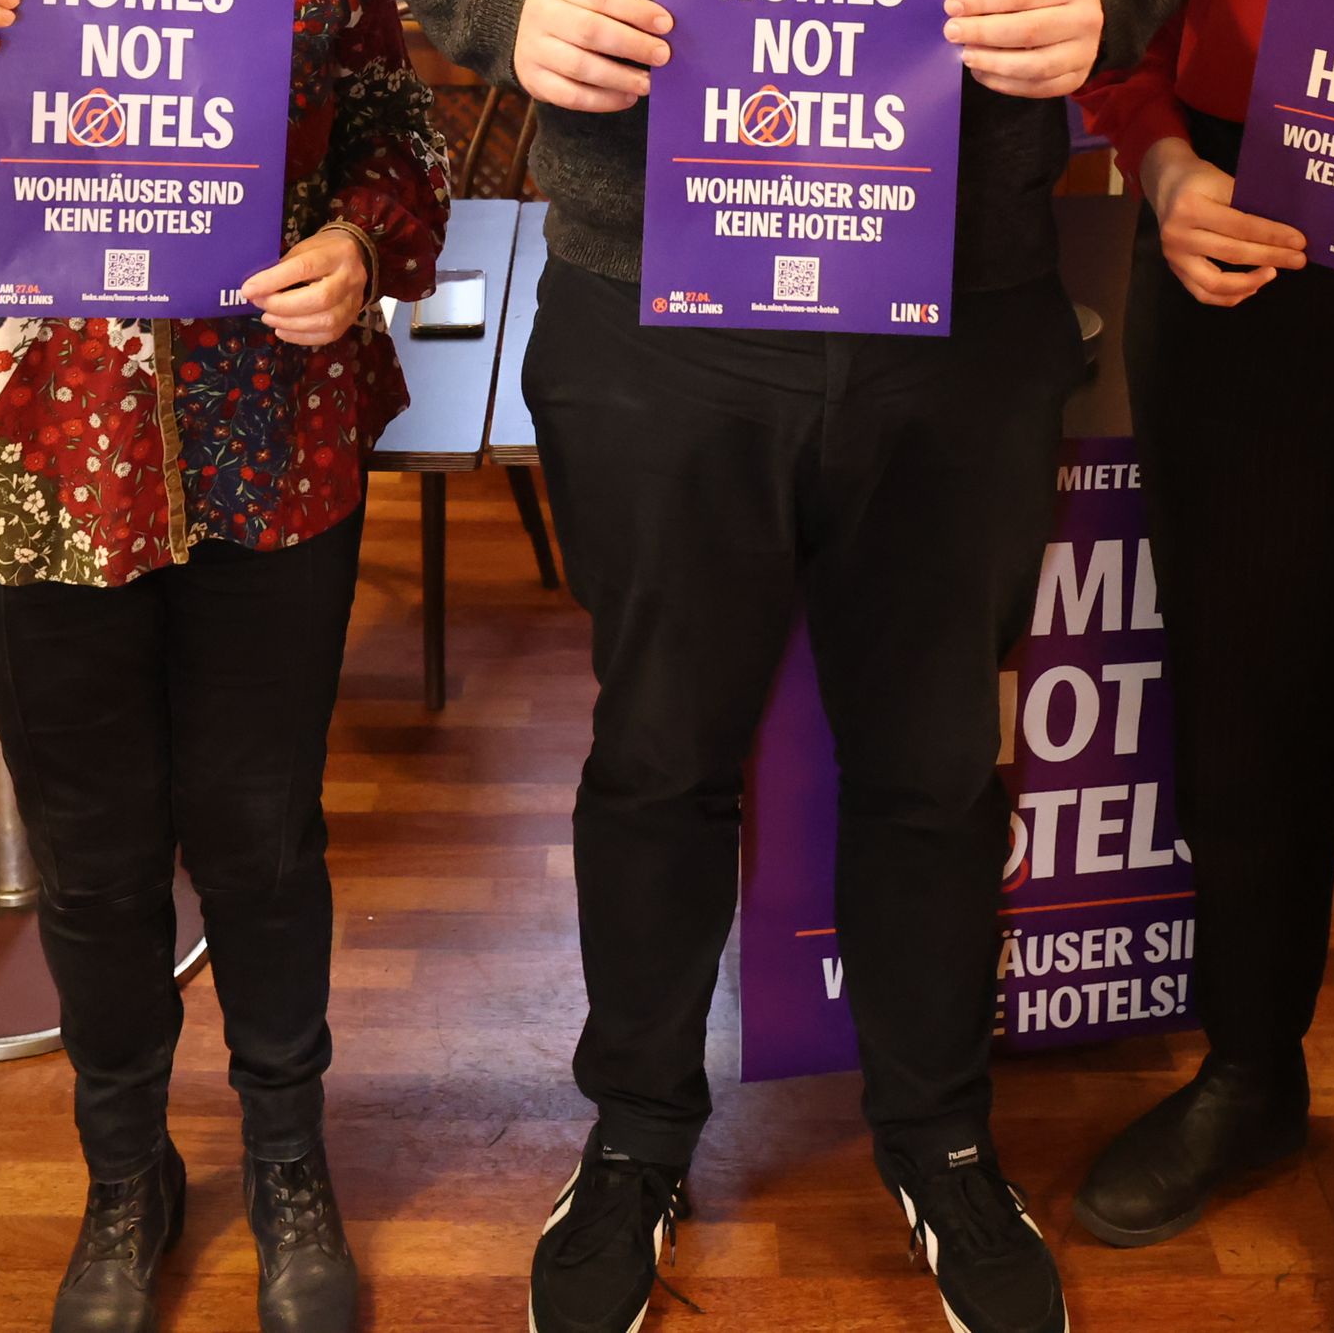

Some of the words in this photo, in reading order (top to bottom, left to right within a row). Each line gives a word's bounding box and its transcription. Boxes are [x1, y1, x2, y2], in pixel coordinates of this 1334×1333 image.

[81, 23, 194, 81] NOT
[752, 18, 865, 77] NOT
[31, 87, 234, 150] HOTELS
[703, 84, 906, 151] HOTELS
[14, 172, 182, 204] WOHNHÄUSER
[187, 179, 244, 205] SIND
[685, 174, 853, 209] WOHNHÄUSER
[858, 184, 916, 211] SIND
[44, 207, 112, 233] KEINE
[118, 209, 212, 234] HOTELS!
[715, 210, 782, 238] KEINE
[788, 213, 883, 243] HOTELS!
[0, 284, 14, 294] AM
[0, 293, 17, 305] KPÖ
[19, 295, 27, 305] &
[28, 295, 53, 305] LINKS
[220, 289, 247, 306] LIN
[670, 291, 684, 302] AM
[669, 300, 688, 313] KPÖ
[689, 303, 697, 314] &
[698, 303, 723, 314] LINKS
[1057, 463, 1142, 492] MIETE
[997, 926, 1133, 979] ÄUSER
[1018, 973, 1188, 1033] HOTELS!
